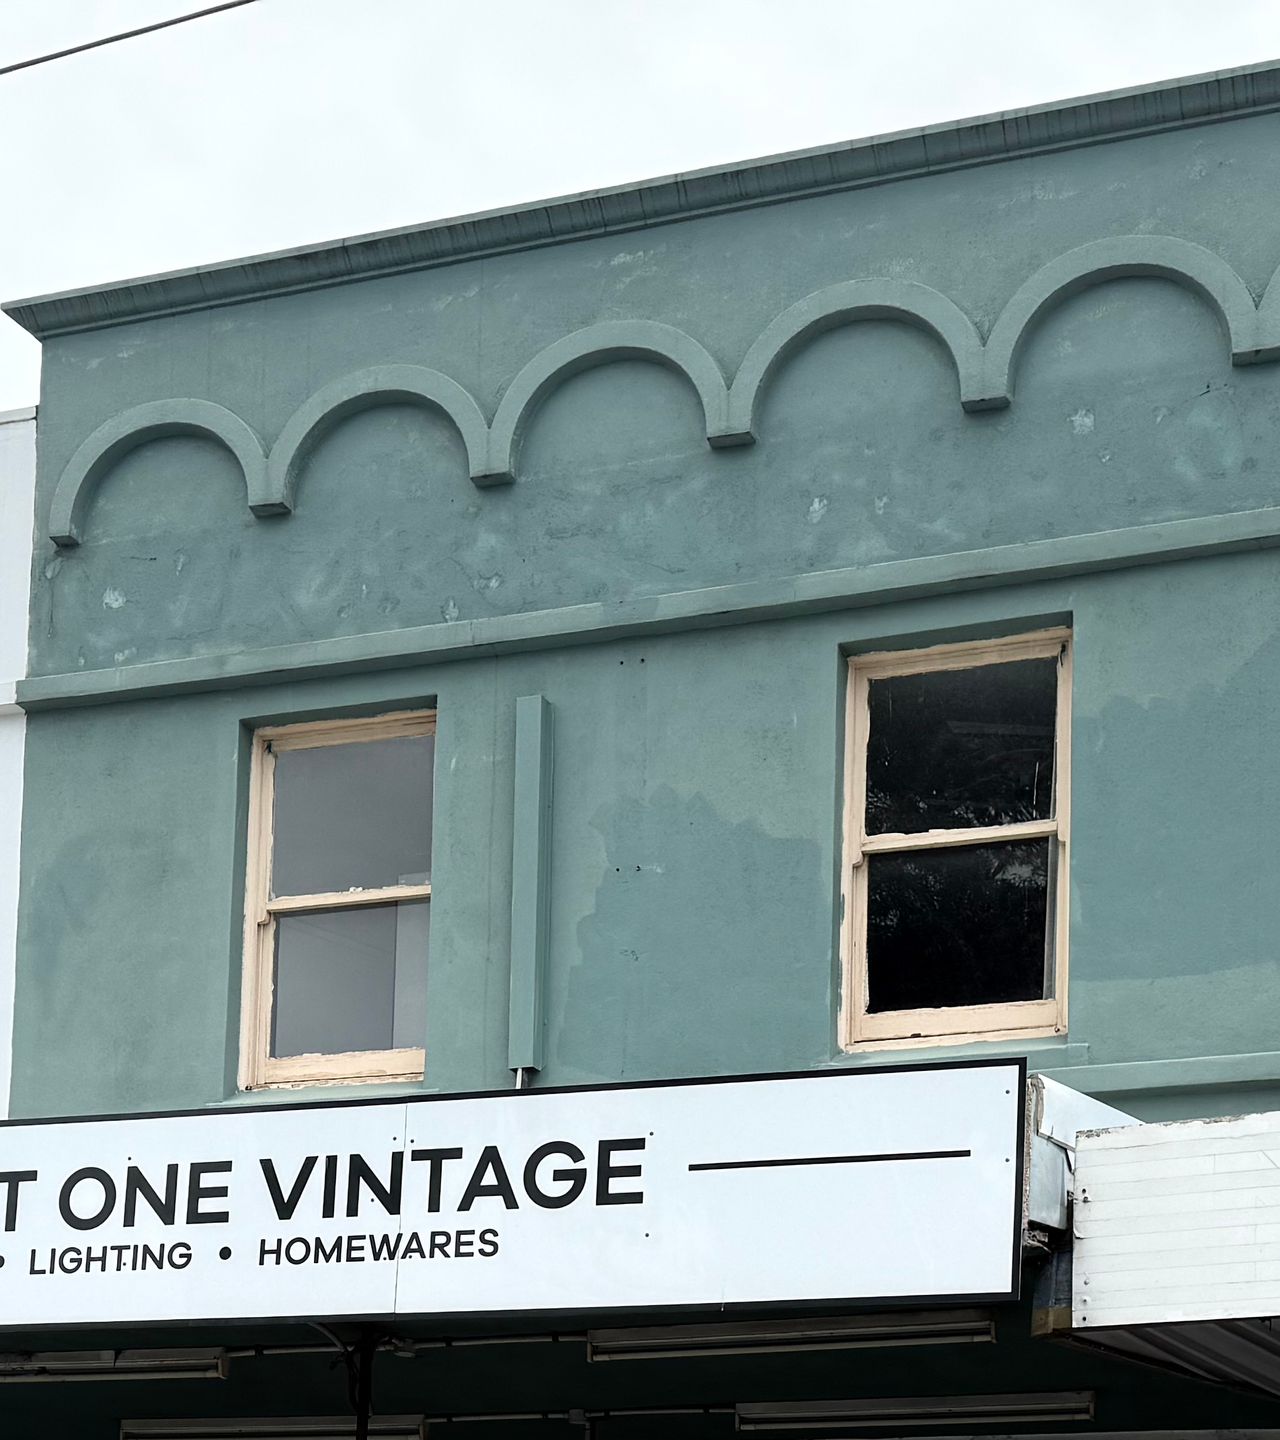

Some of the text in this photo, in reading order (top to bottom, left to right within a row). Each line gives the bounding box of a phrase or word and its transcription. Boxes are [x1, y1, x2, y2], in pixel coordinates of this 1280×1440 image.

[58, 1159, 234, 1232] ONE
[259, 1137, 647, 1221] VINTAGE
[28, 1241, 194, 1276] LIGHTING
[257, 1227, 500, 1267] HOMEWARES
